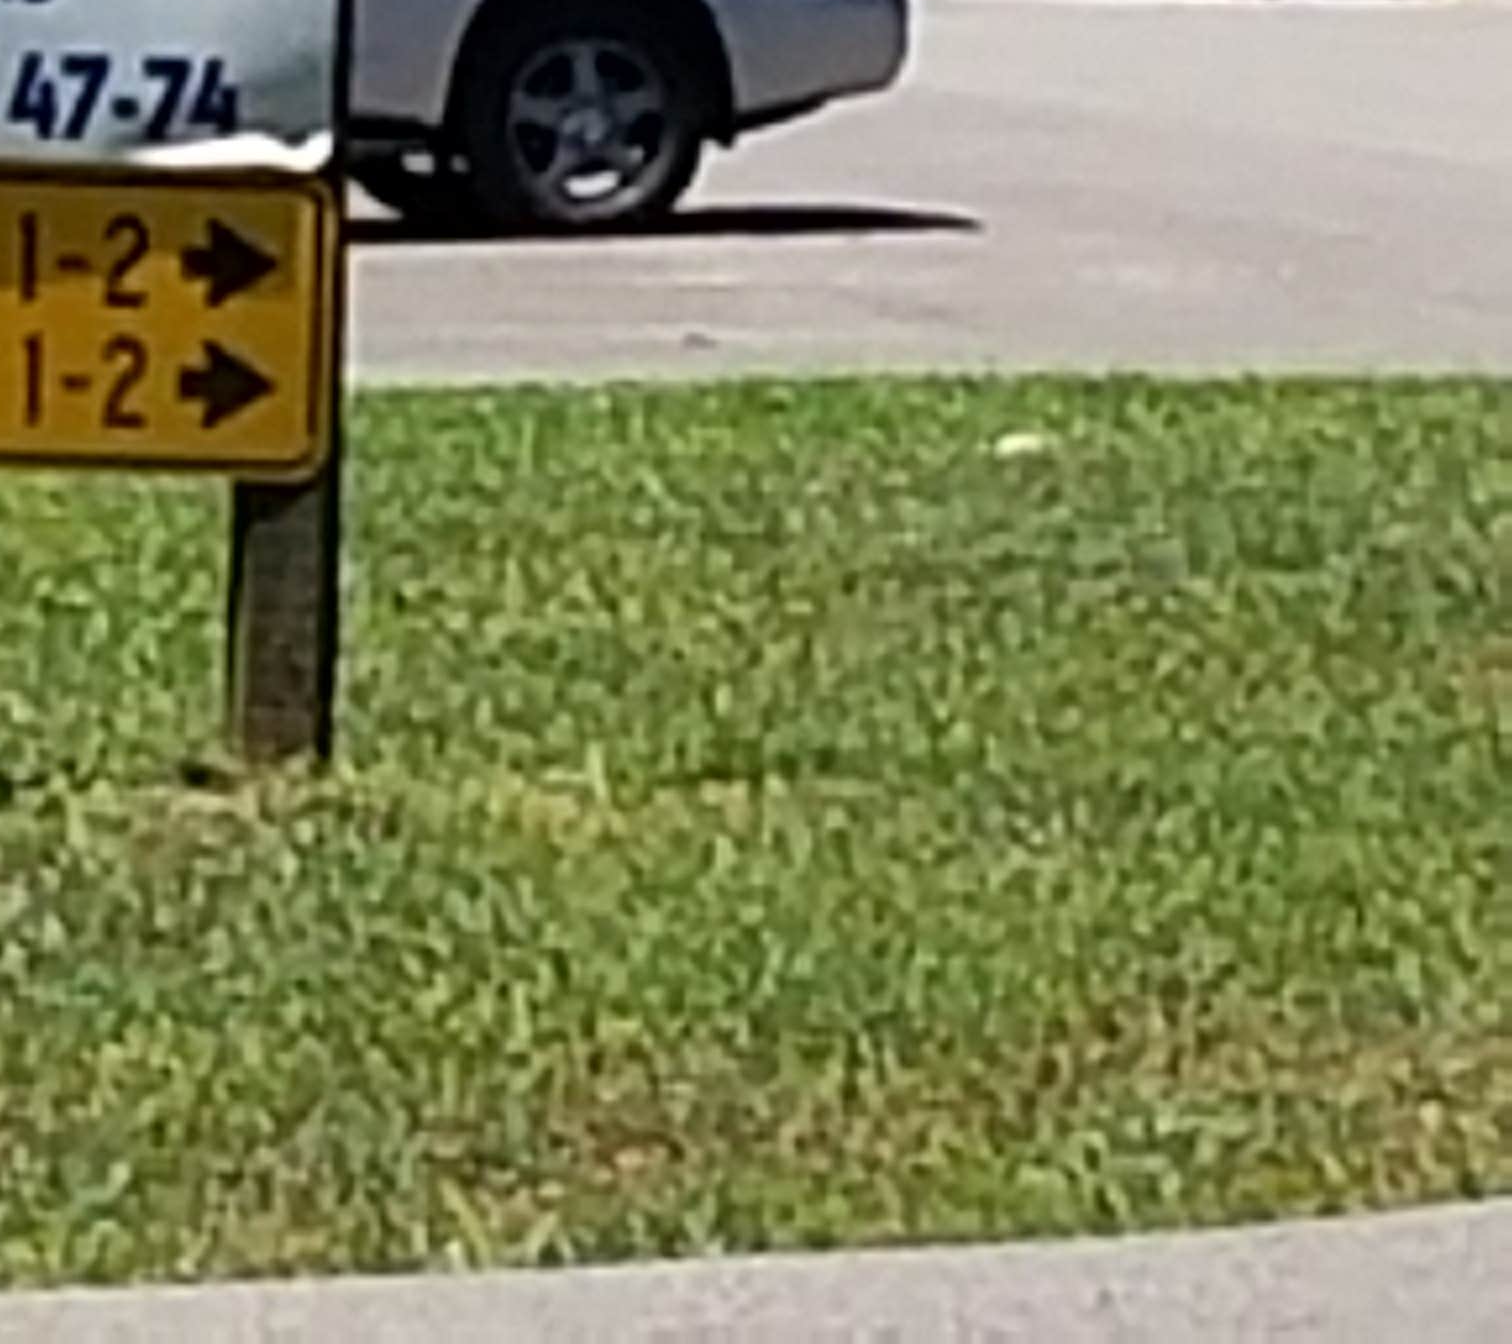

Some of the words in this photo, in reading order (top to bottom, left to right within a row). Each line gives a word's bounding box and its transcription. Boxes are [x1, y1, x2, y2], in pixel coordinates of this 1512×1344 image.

[7, 52, 240, 140] 47-74
[18, 213, 149, 307] 1-2
[23, 332, 148, 428] 1-2
